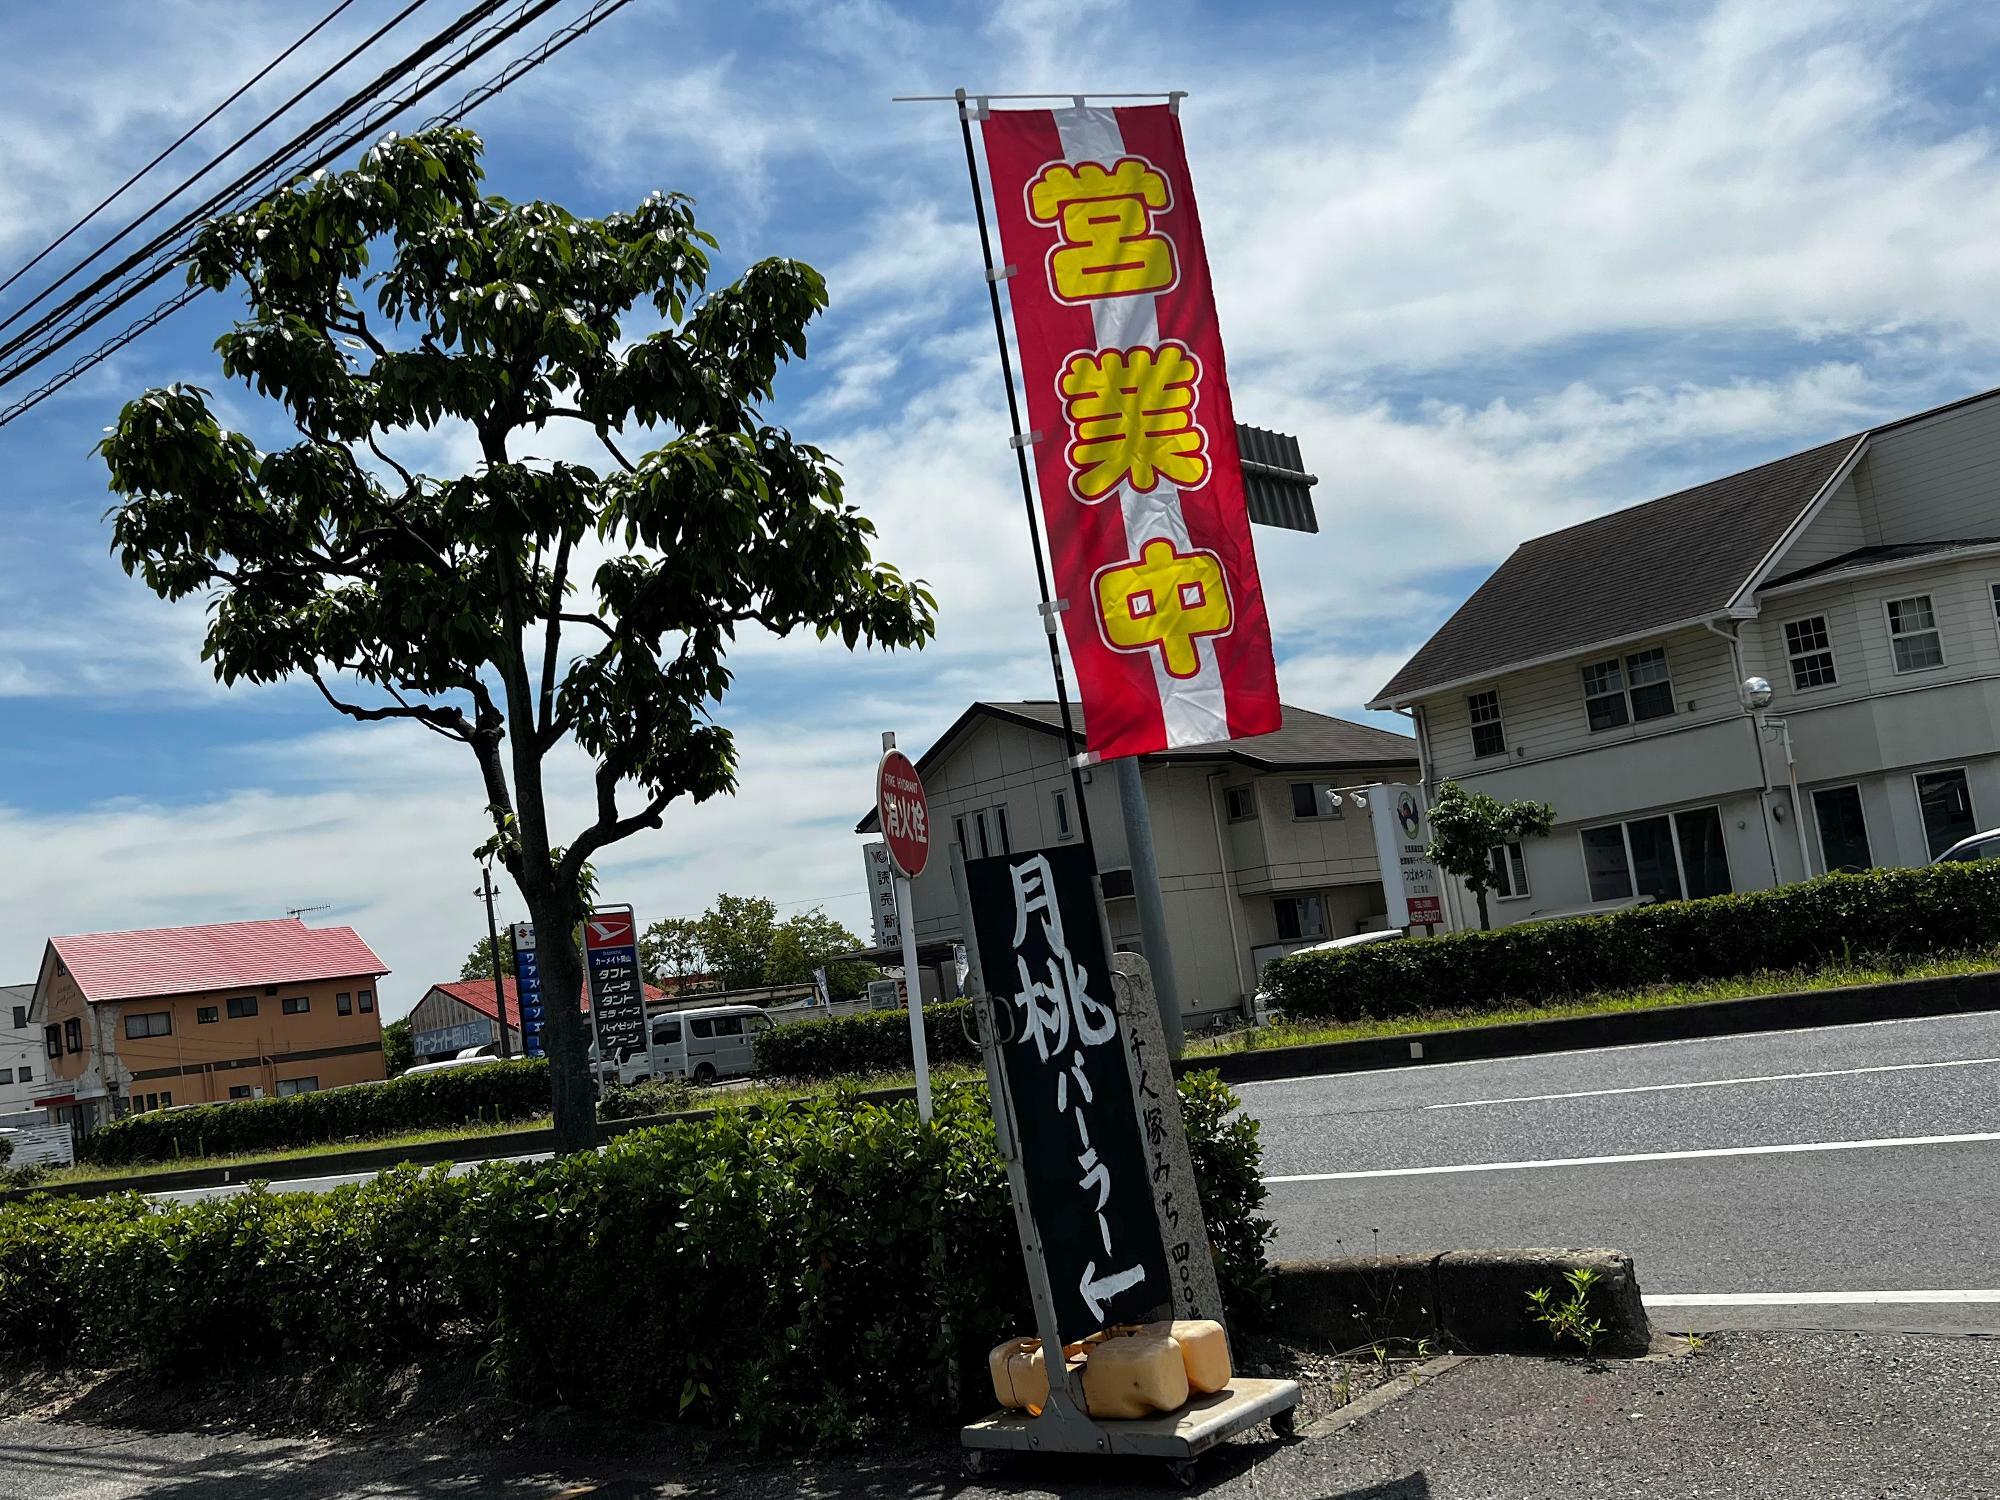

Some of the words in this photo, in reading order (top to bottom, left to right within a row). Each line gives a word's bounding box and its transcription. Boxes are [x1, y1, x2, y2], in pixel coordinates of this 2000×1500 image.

[1024, 157, 1234, 679] 営業中
[885, 773, 896, 787] FIRE
[897, 777, 917, 794] HYDRANT
[883, 791, 927, 843] 消火栓
[599, 968, 630, 980] タフト
[602, 980, 630, 993] ムーヴ
[601, 994, 634, 1006] タント
[601, 1020, 642, 1033] ハイゼット
[1010, 853, 1117, 1257] 月桃パーラー
